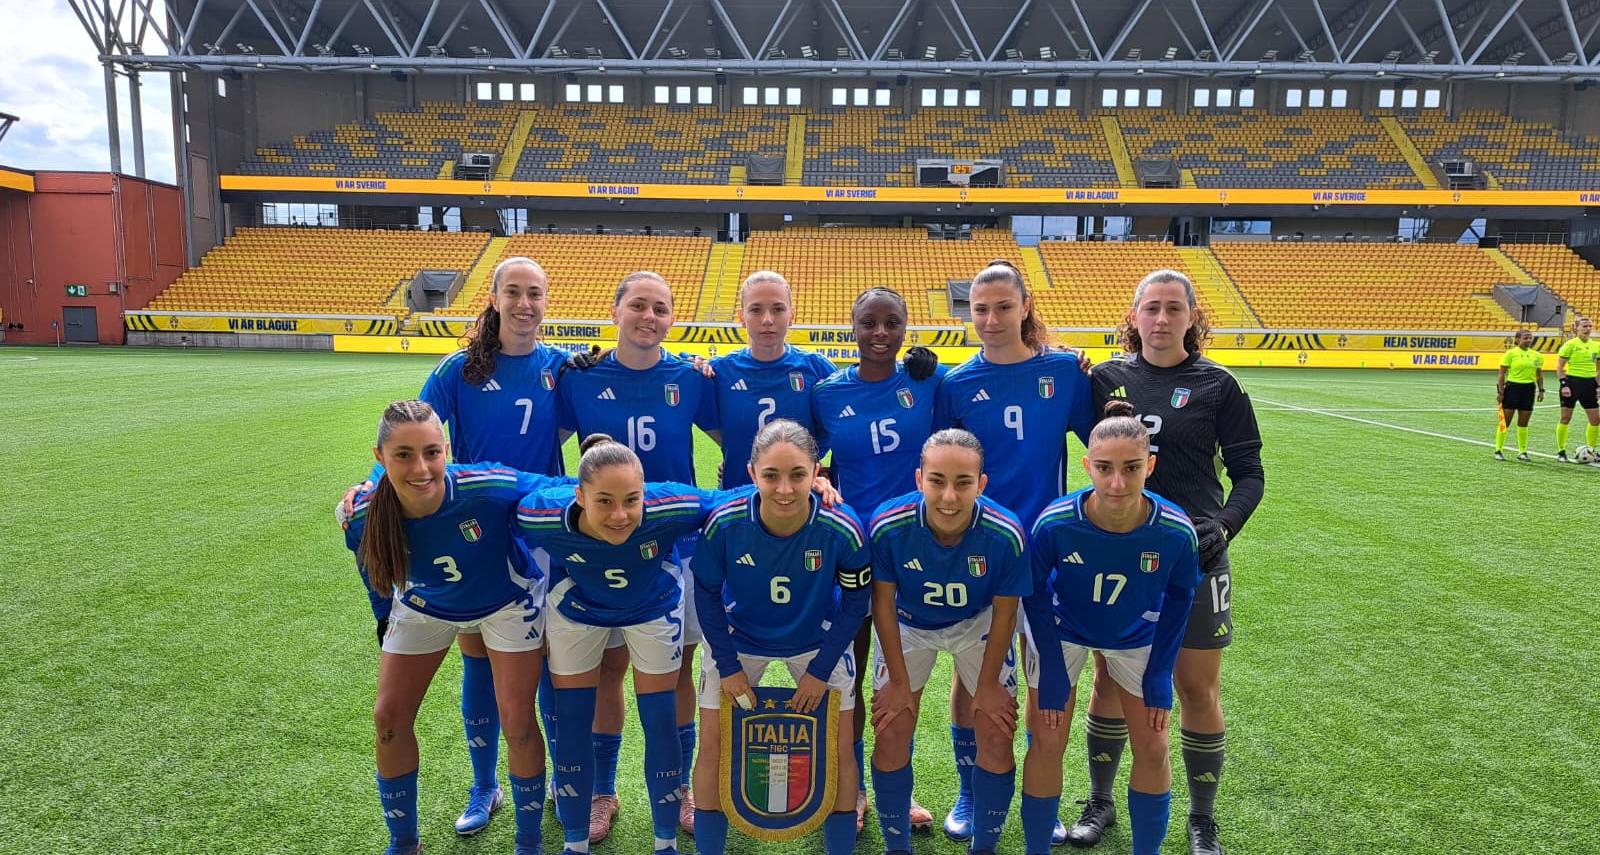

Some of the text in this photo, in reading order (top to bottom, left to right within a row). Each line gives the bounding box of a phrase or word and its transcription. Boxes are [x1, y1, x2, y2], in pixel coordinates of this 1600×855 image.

[357, 181, 387, 189] SVERIGE
[588, 186, 595, 194] VI
[826, 190, 833, 198] VI
[847, 190, 877, 198] SVERIGE
[1066, 191, 1073, 199] VI
[1313, 192, 1320, 200] VI
[1335, 192, 1366, 201] SVERIGE
[228, 319, 238, 329] VI
[557, 325, 600, 338] SVERIGE!
[809, 331, 819, 342] VI
[1104, 334, 1114, 345] VI
[1384, 336, 1457, 349] HEJA SVERIGE!
[1413, 355, 1422, 364] VI
[515, 398, 533, 435] 7
[758, 398, 776, 431] 2
[1004, 405, 1024, 440] 9
[627, 416, 656, 451] 16
[870, 418, 901, 455] 15
[433, 555, 462, 582] 3
[604, 569, 628, 589] 5
[1093, 573, 1127, 605] 17
[770, 576, 791, 604] 6
[923, 581, 968, 607] 20
[1210, 573, 1230, 613] 12
[516, 591, 540, 622] 3
[748, 723, 810, 744] ITALIA
[770, 744, 788, 753] FIGC
